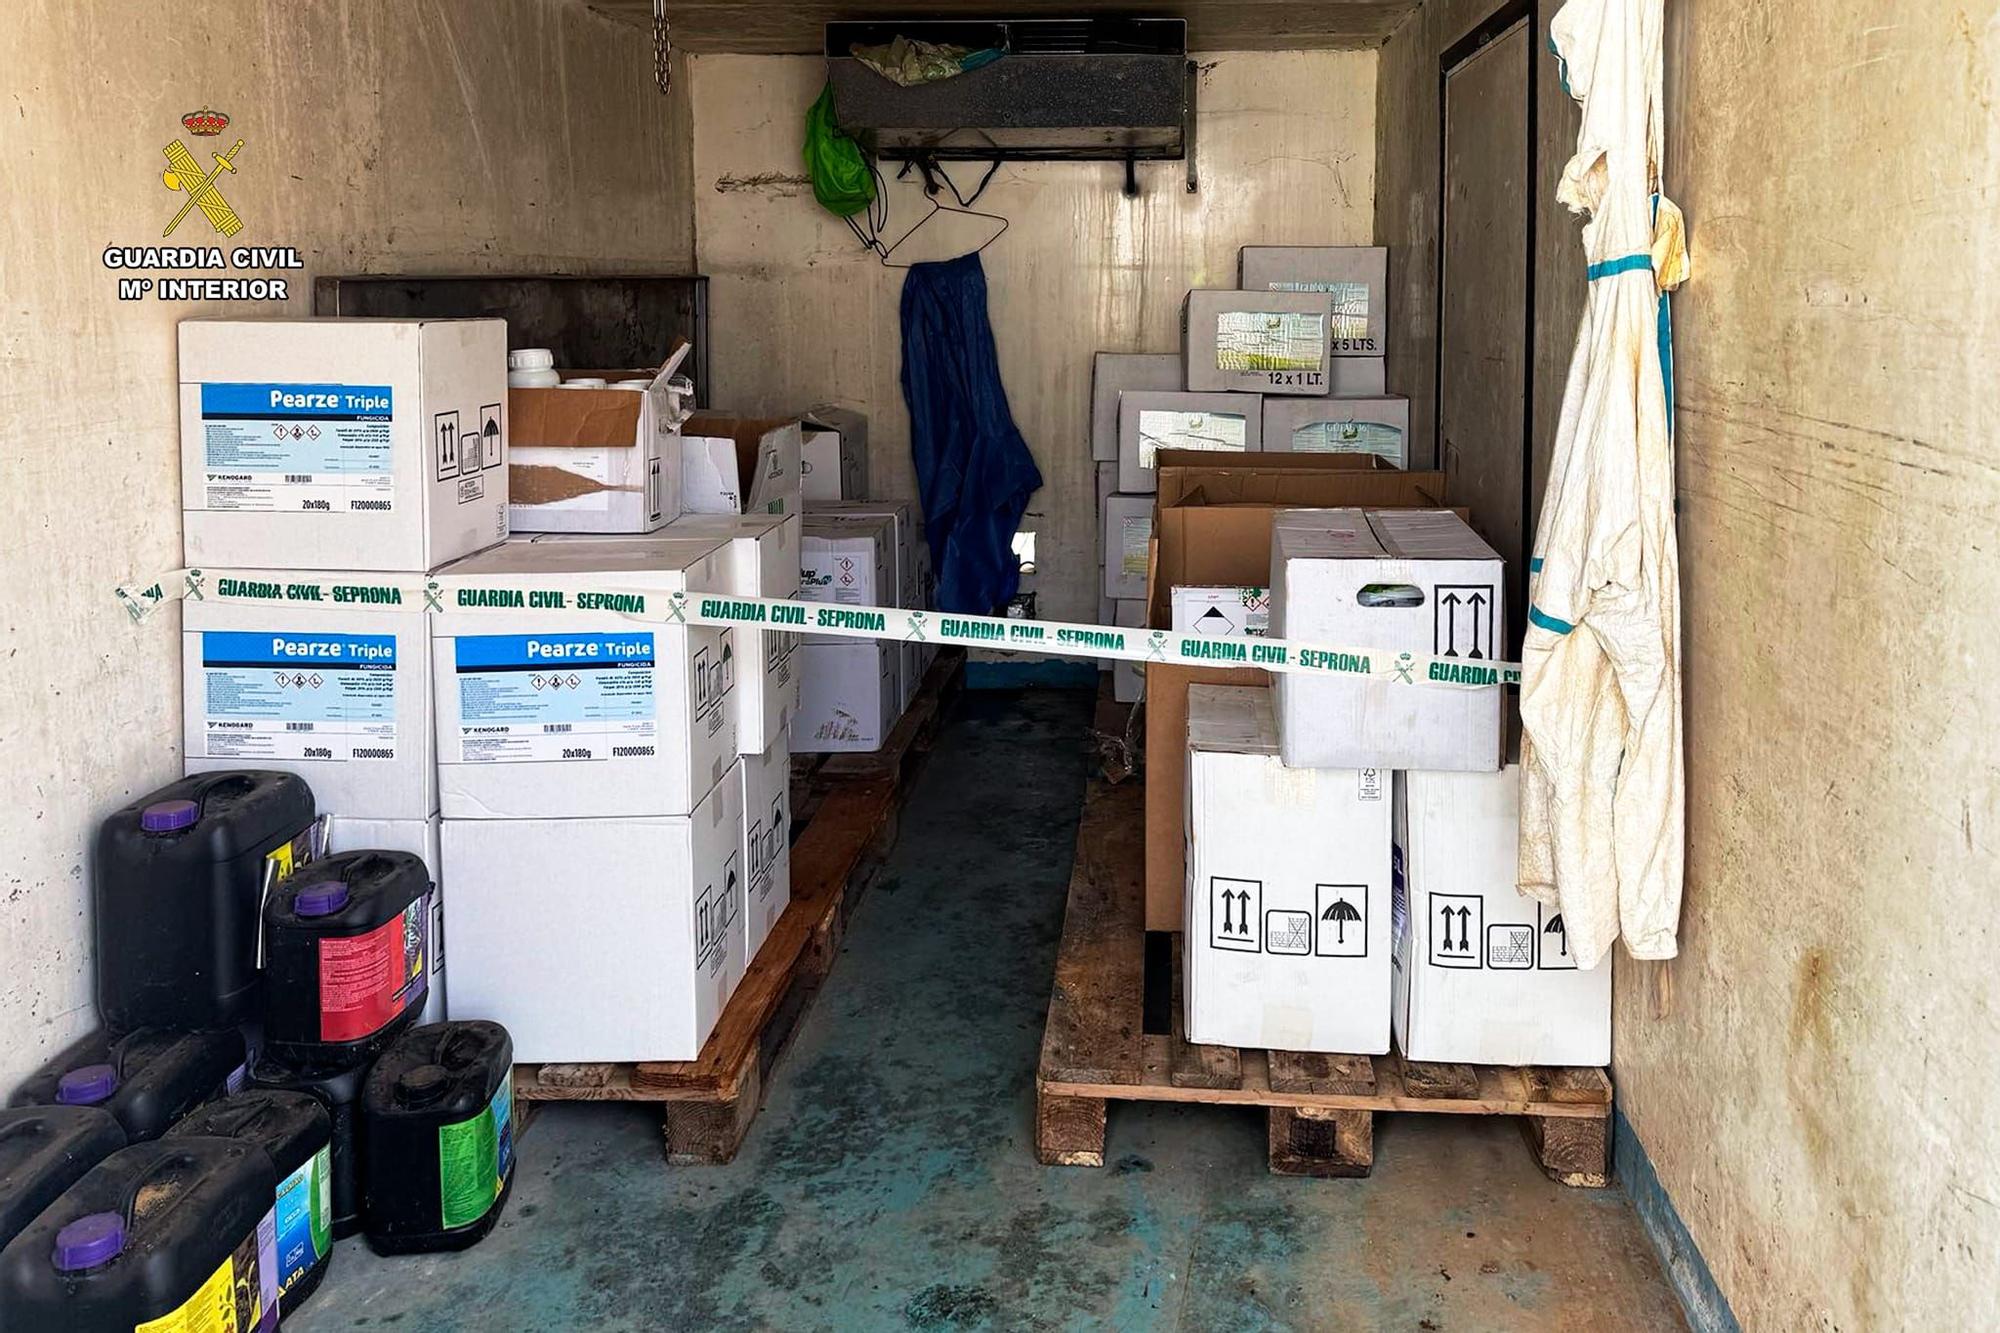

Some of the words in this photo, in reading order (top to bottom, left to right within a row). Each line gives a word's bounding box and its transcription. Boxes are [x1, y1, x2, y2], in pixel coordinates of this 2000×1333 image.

[1342, 340, 1349, 351] 5
[1352, 339, 1378, 352] LTS.
[1268, 373, 1283, 384] 12
[1285, 375, 1293, 384] x
[1296, 373, 1302, 385] 1
[1306, 373, 1323, 385] LT.
[270, 390, 339, 407] Pearze
[345, 395, 389, 411] Triple
[302, 500, 330, 511] 20x180g
[218, 578, 282, 598] GUARDIA
[333, 587, 402, 605] SEPRONA
[457, 588, 525, 608] GUARDIA
[576, 592, 646, 613] SEPRONA
[700, 599, 767, 622] GUARDIA
[817, 608, 886, 632] SEPRONA
[940, 618, 1006, 642] GUARDIA
[1056, 628, 1125, 651] SEPRONA
[272, 638, 342, 657] Pearze
[348, 643, 392, 660] Triple
[527, 640, 599, 658] Pearze
[605, 641, 651, 658] Triple
[1180, 639, 1247, 662] GUARDIA
[1299, 650, 1371, 674] SEPRONA
[1428, 662, 1499, 685] GUARDIA
[303, 748, 332, 759] 20x180g
[562, 748, 592, 759] 20x180g
